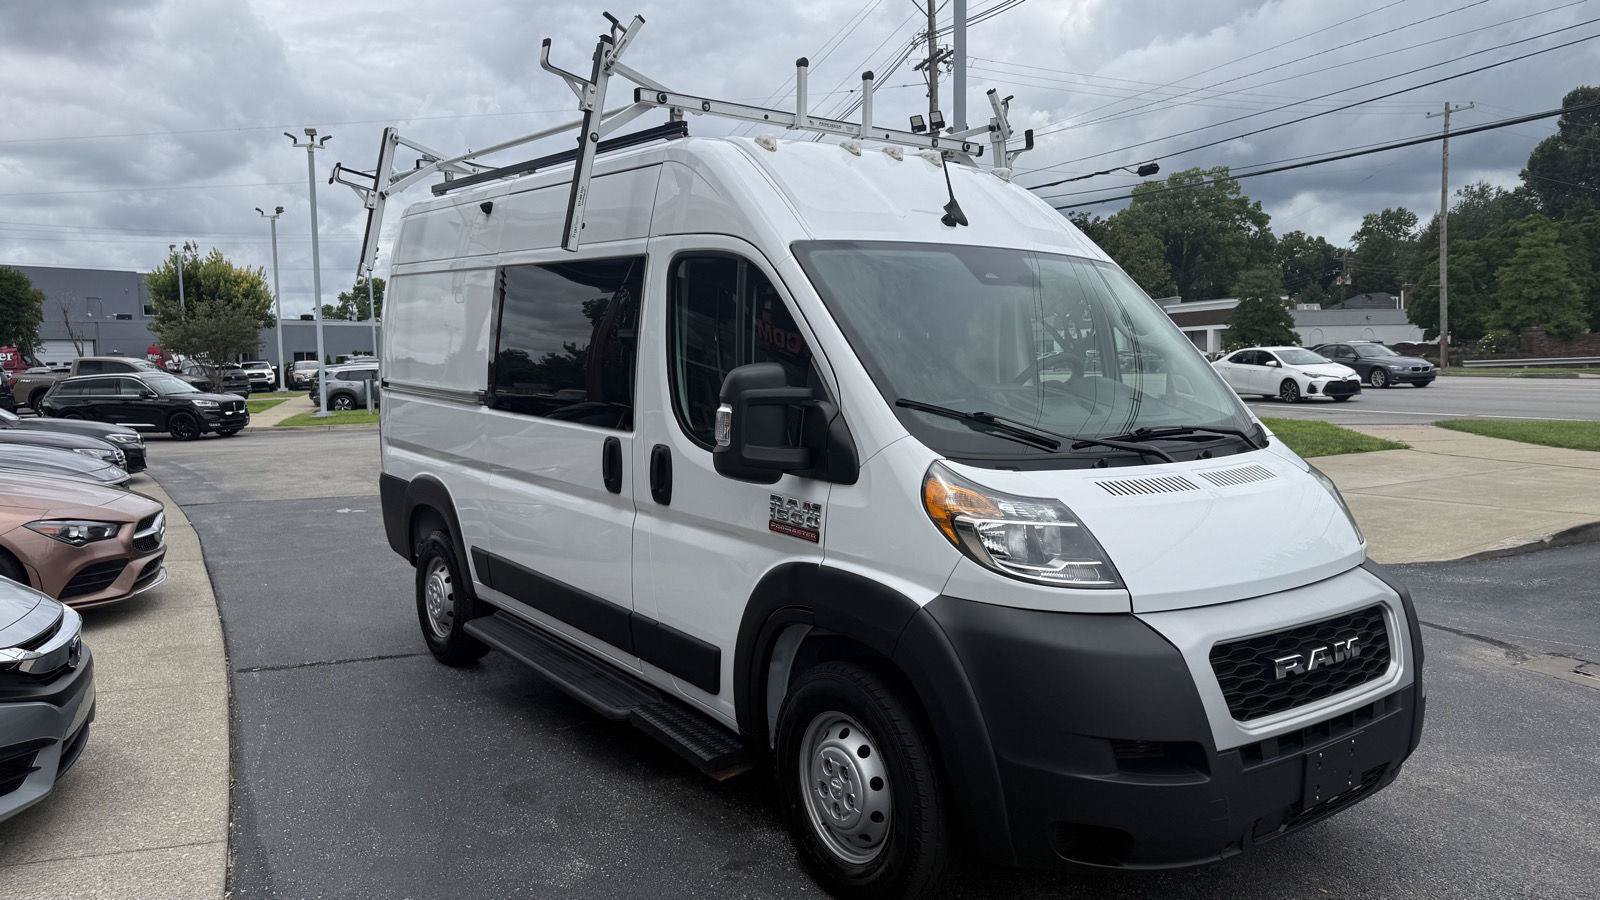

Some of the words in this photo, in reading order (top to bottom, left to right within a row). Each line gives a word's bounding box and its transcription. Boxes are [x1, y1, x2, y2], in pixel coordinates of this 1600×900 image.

[769, 493, 822, 518] RAM
[769, 507, 821, 530] 1500
[1274, 637, 1361, 680] RAM
